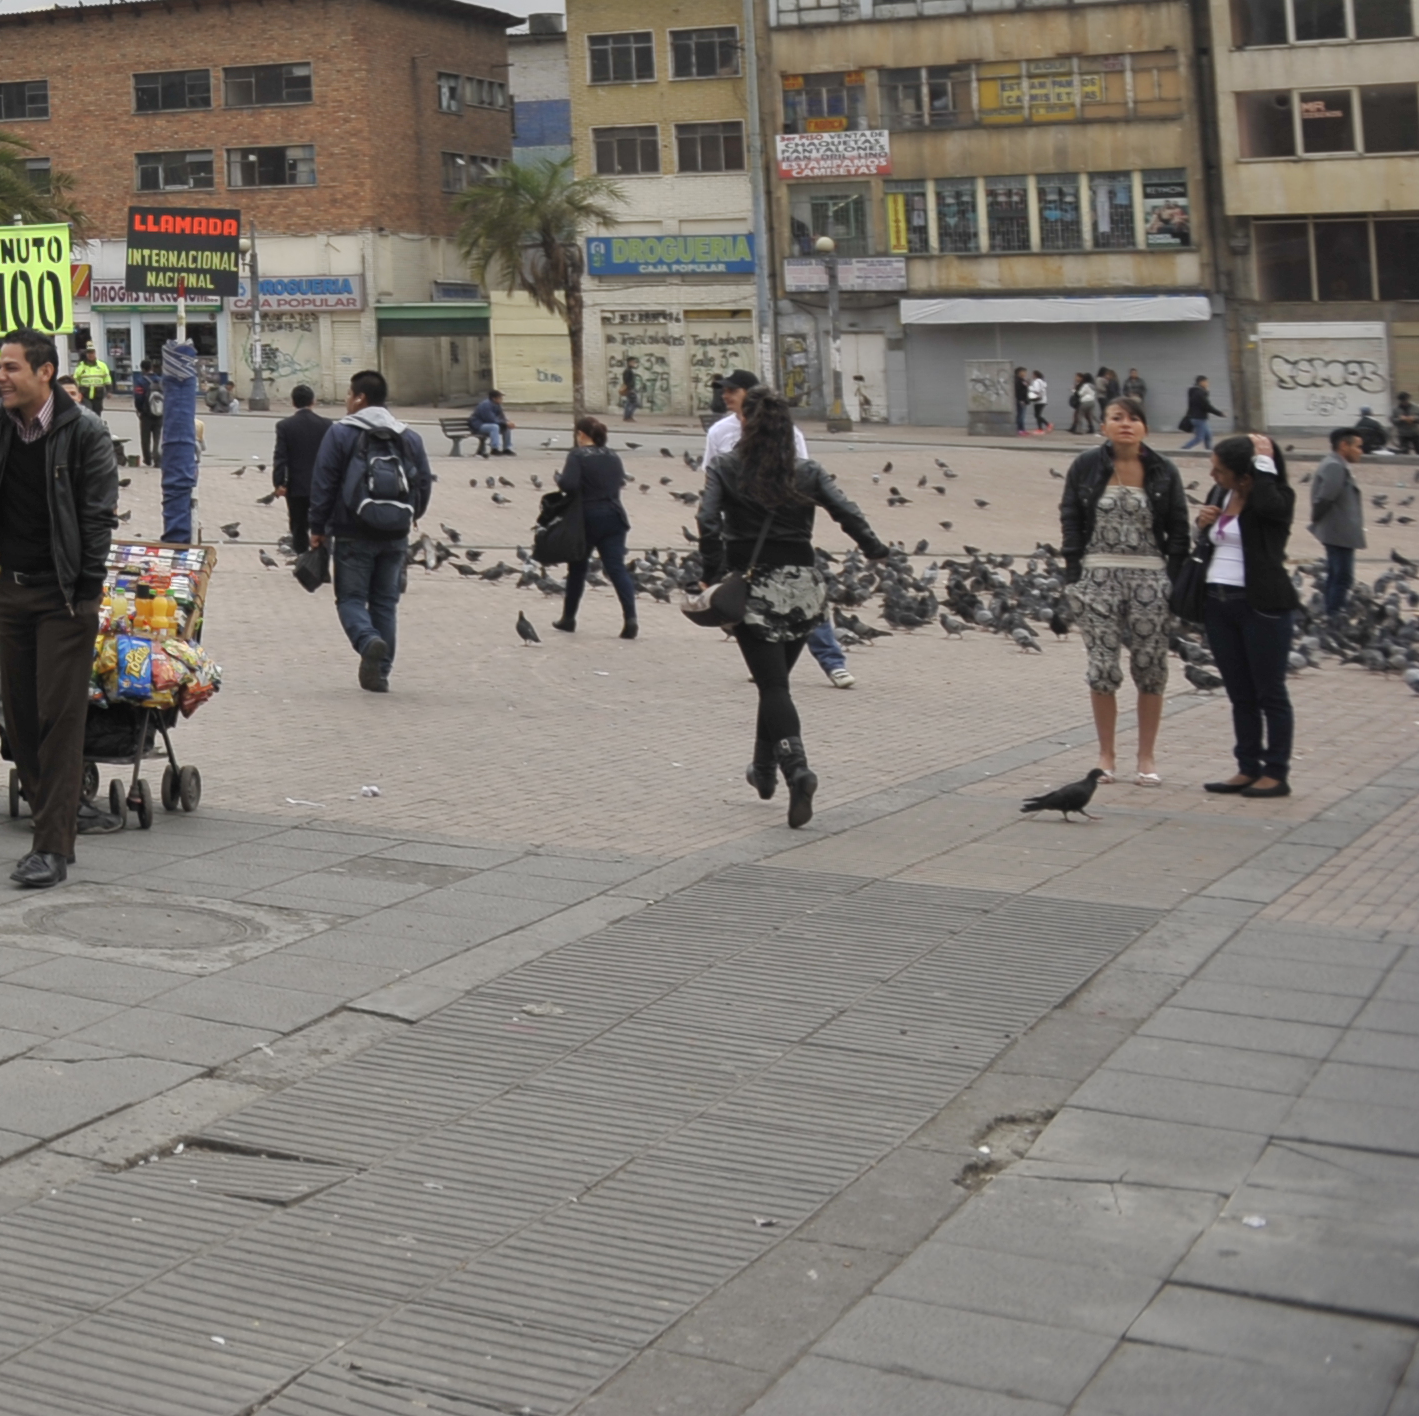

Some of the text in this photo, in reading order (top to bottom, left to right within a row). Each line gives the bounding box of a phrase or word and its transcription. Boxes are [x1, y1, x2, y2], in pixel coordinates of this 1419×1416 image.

[829, 132, 867, 140] VENTA
[784, 138, 881, 149] CHAQUETAS
[781, 144, 886, 155] PANTALONES
[782, 158, 888, 171] ESTAMPAMOS
[791, 166, 878, 177] CAMISETAS
[133, 214, 238, 236] LLAMADA
[613, 236, 751, 263] DROGUERIA
[127, 247, 238, 273] INTERNACIONAL
[639, 263, 727, 273] CAJA POPULAR
[234, 297, 357, 309] CAA POPULAR
